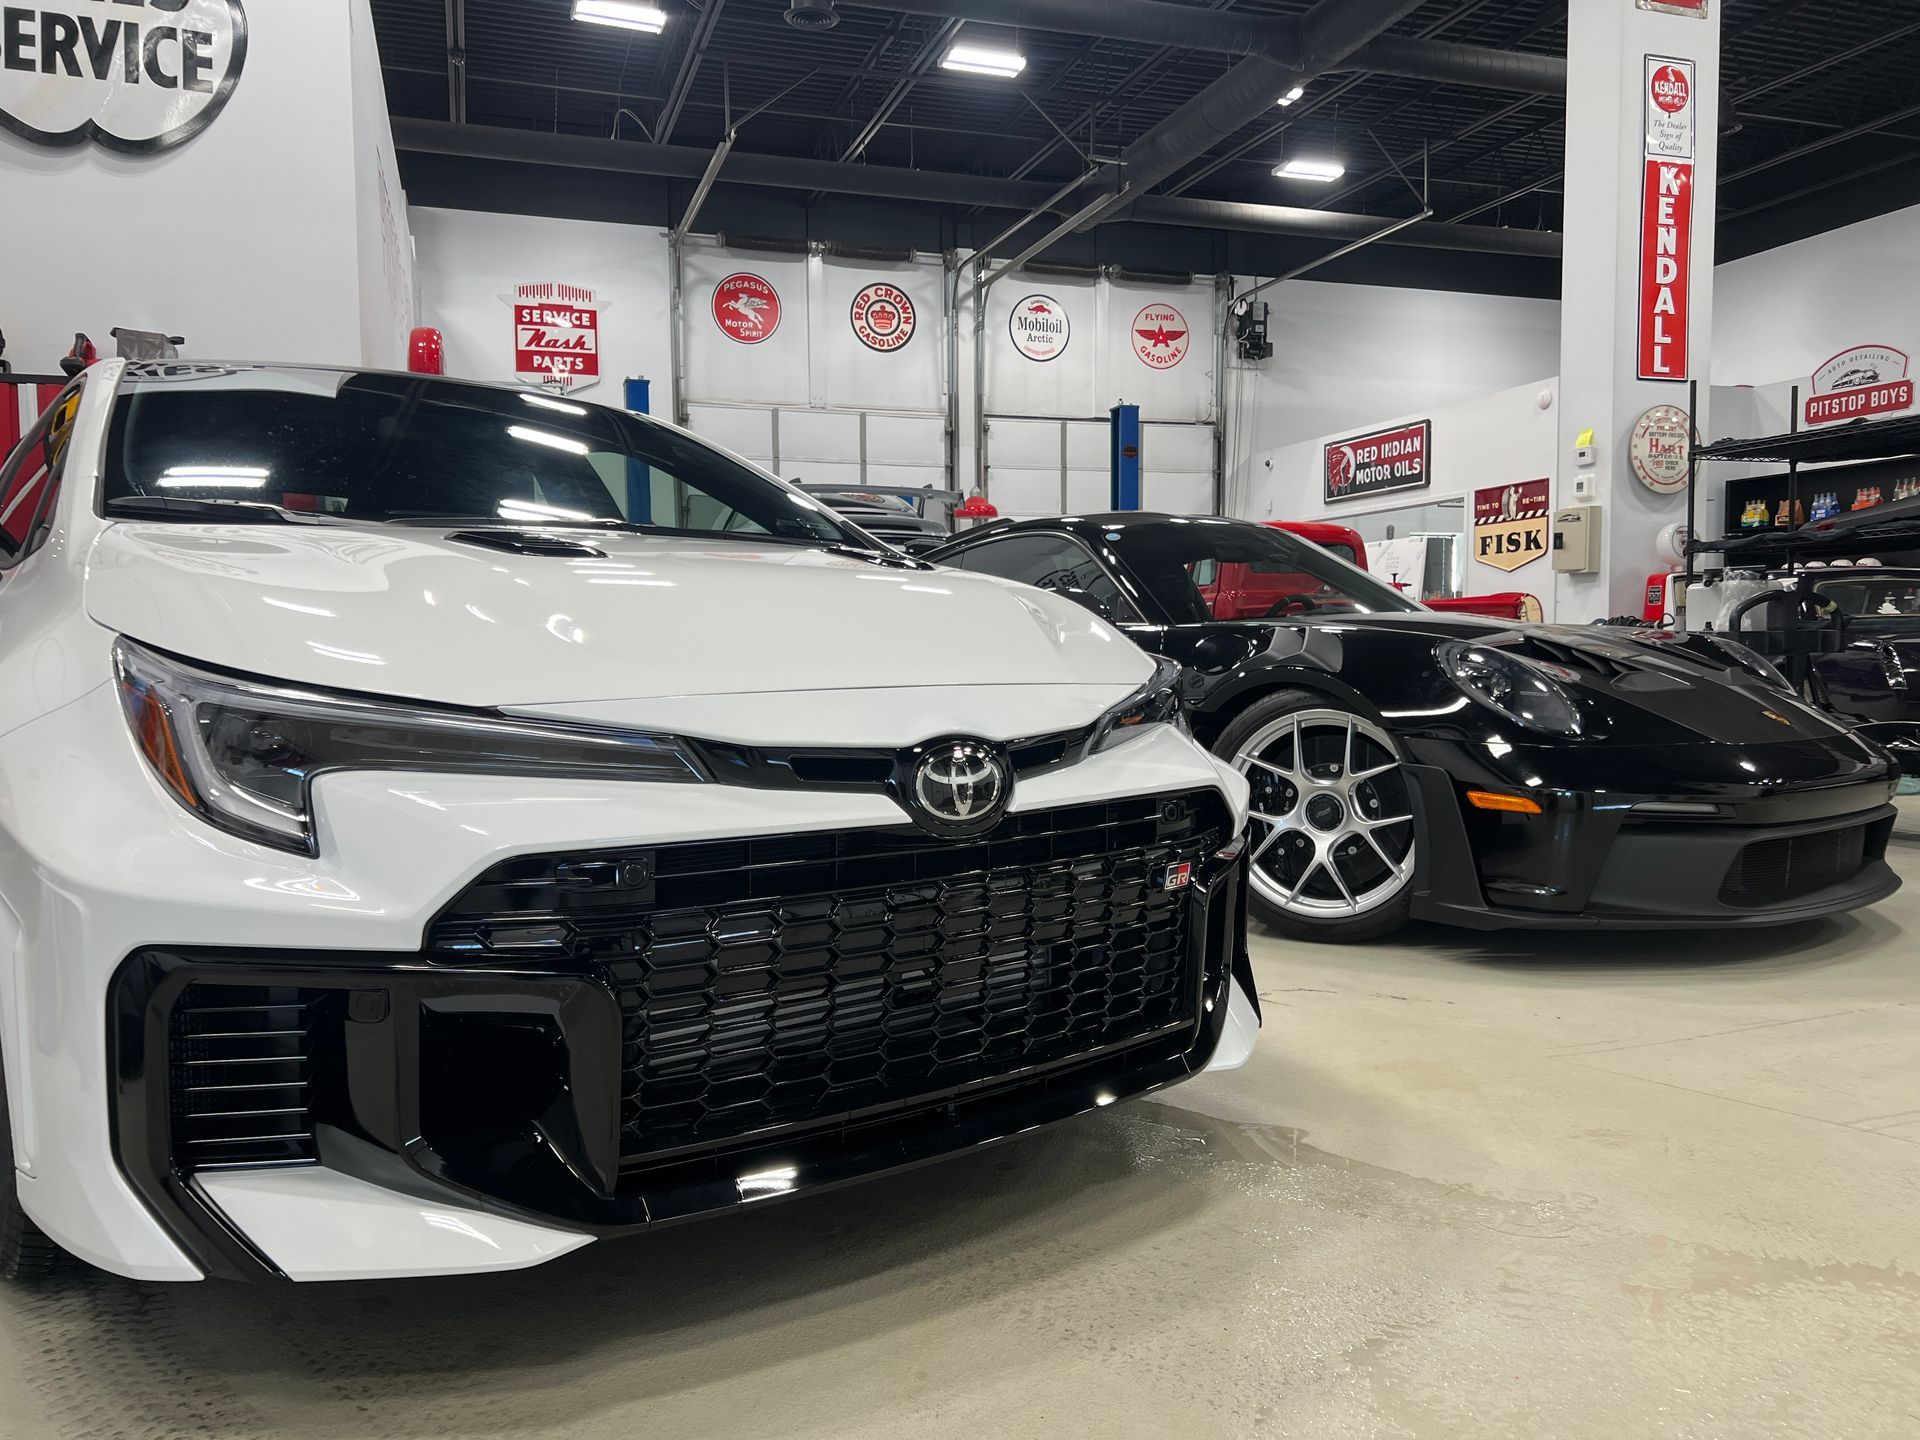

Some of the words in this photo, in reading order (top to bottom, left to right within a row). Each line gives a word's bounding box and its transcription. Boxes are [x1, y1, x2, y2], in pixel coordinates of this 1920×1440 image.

[0, 6, 214, 94] ERVICE
[1654, 81, 1687, 97] KENDALL
[1653, 120, 1666, 128] The
[1667, 121, 1688, 129] Dealer
[1660, 130, 1674, 140] Sign
[1675, 133, 1683, 141] of
[1659, 141, 1683, 153] Quality
[1653, 166, 1679, 373] KENDALL
[723, 280, 769, 294] PEGASUS
[854, 293, 871, 321] RED
[874, 287, 912, 325] CROWN
[521, 309, 591, 326] SERVICE
[1017, 316, 1062, 334] Mobiloil
[1145, 313, 1175, 321] FLYING
[520, 328, 593, 351] Nash
[858, 325, 909, 347] GASOLINE
[1026, 333, 1054, 344] Arctic
[533, 355, 584, 370] PARTS
[1140, 345, 1182, 364] GASOLINE
[1827, 360, 1846, 375] AUTO
[1849, 353, 1890, 363] DETAILING
[1809, 393, 1866, 418] PITSTOP
[1870, 386, 1908, 408] BOYS
[1356, 446, 1378, 465] RED
[1381, 436, 1421, 459] INDIAN
[1356, 464, 1391, 485] MOTOR
[1394, 458, 1421, 478] OILS
[1479, 529, 1543, 556] FISK
[1168, 872, 1188, 886] GR
